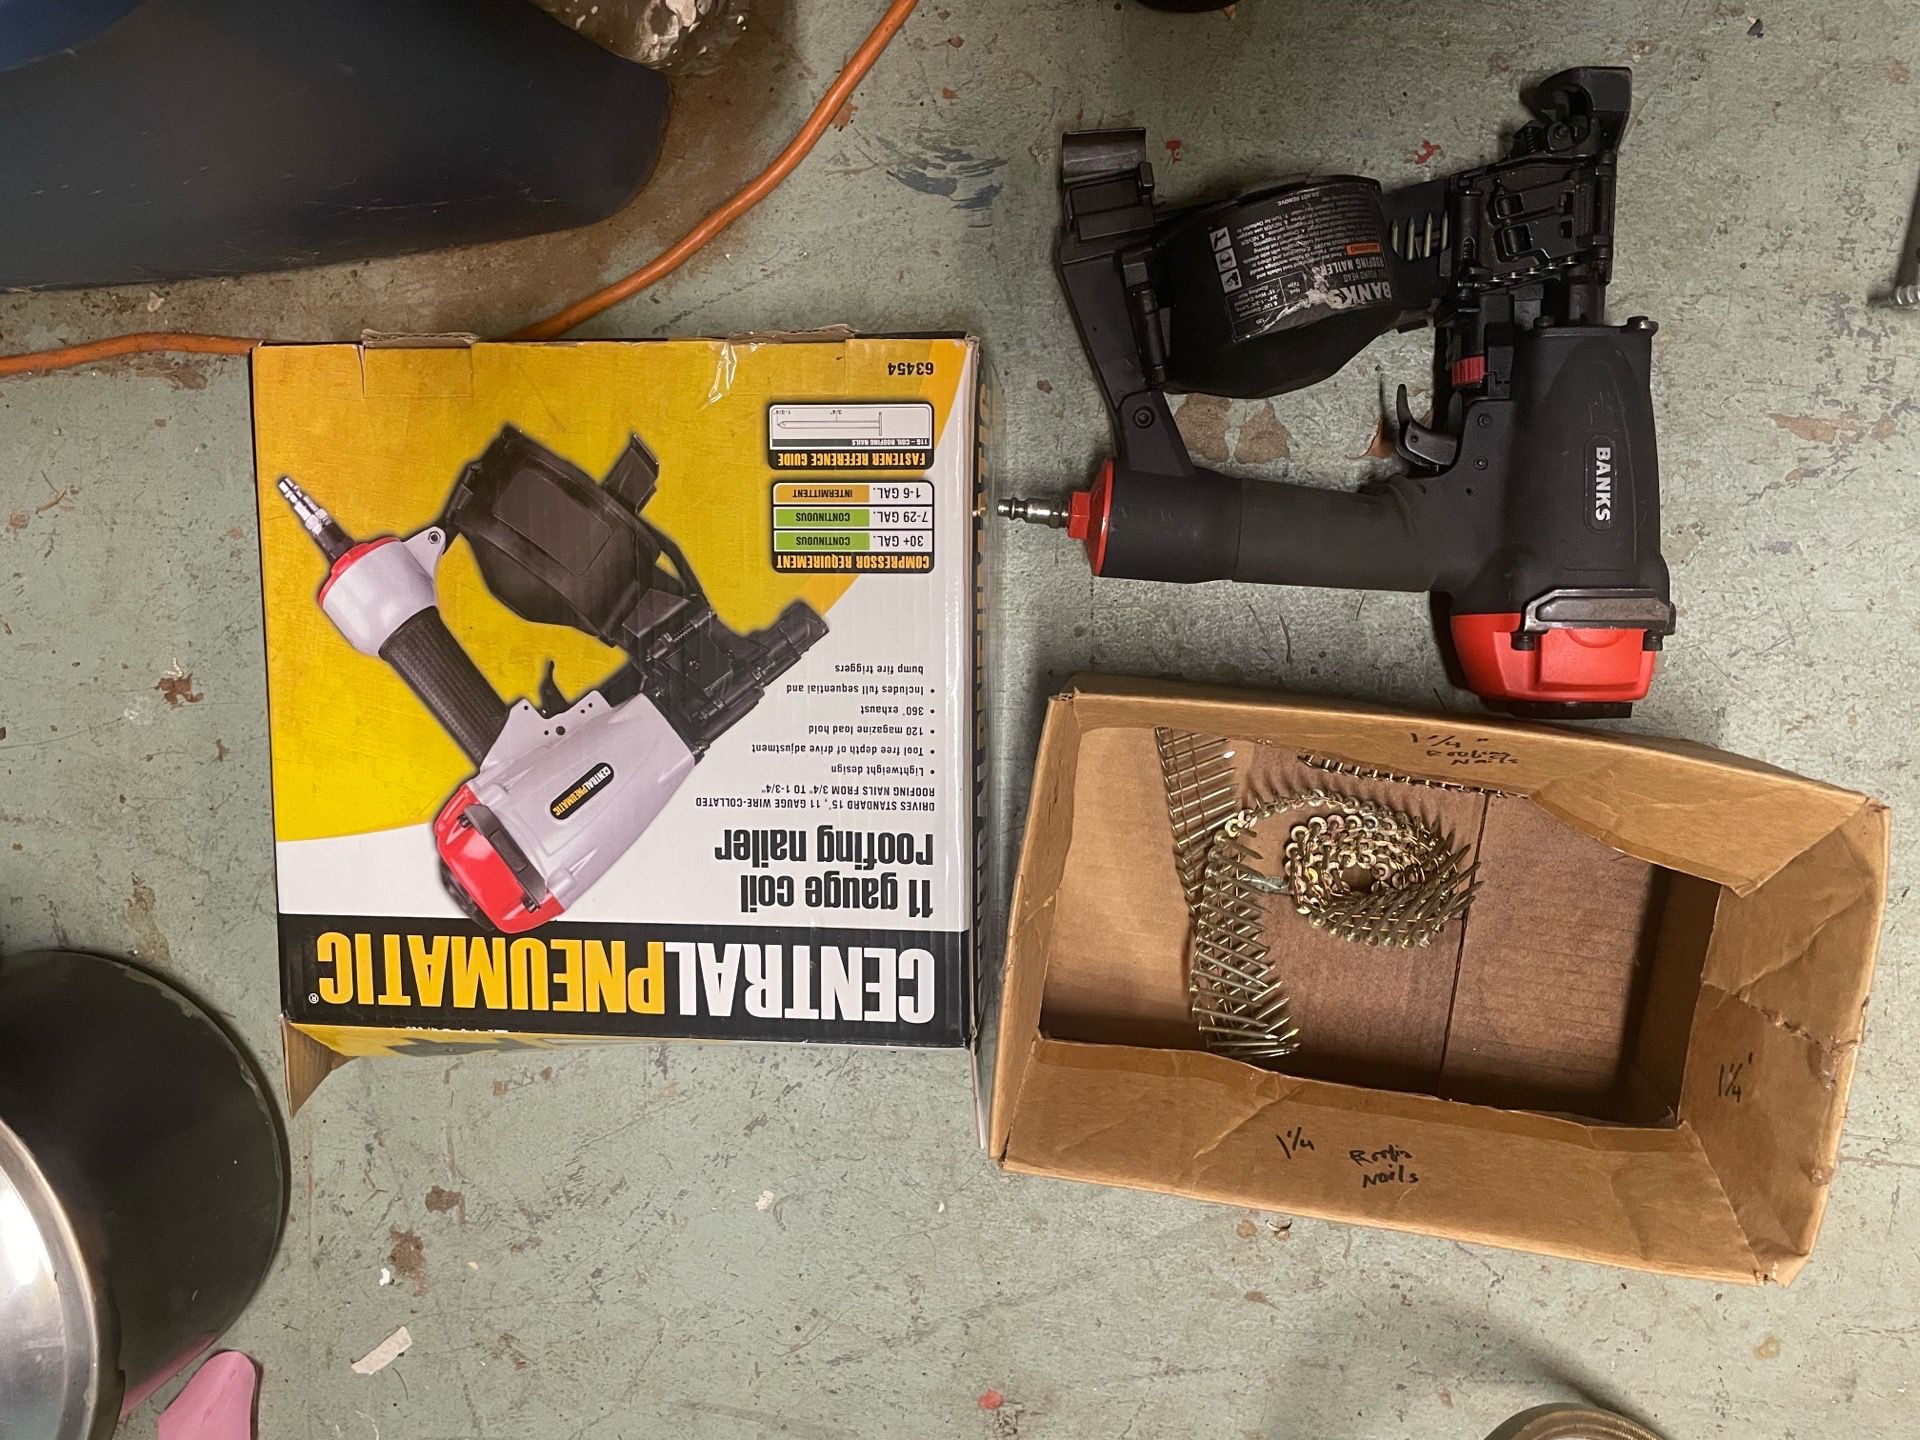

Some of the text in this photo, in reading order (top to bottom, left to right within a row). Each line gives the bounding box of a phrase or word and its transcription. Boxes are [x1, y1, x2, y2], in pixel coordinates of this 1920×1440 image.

[1327, 282, 1392, 307] BANKS
[888, 362, 934, 376] 63454
[777, 452, 926, 466] FASTENER REFERENCE GUIDE
[1596, 447, 1610, 520] BANKS
[793, 487, 922, 499] 1-6 GAL. INTERMITTENT
[796, 511, 928, 523] 7-29 GAL. CONTINUOUS
[796, 535, 924, 547] 30+ GAL. CONTINUOUS
[776, 554, 930, 569] COMPRESSOR REQUIREMENT
[835, 663, 924, 674] bump fire triggers
[786, 682, 924, 695] Includes full sequential and
[860, 706, 898, 715] exhaust
[808, 724, 924, 735] 120 magazine load hold
[752, 743, 924, 756] Tool free depth of drive adjustment
[831, 764, 924, 776] Lightweight design
[762, 784, 934, 796] ROOFING NAILS FROM 3/4" TO 1-3/4"
[695, 797, 771, 808] WIRE-COLLATED
[774, 798, 806, 808] GAUGE
[810, 799, 820, 809] 11
[847, 800, 897, 811] STANDARD
[900, 801, 934, 811] DRIVES
[714, 825, 933, 870] roofing nailer
[741, 871, 933, 918] 11 gauge coil
